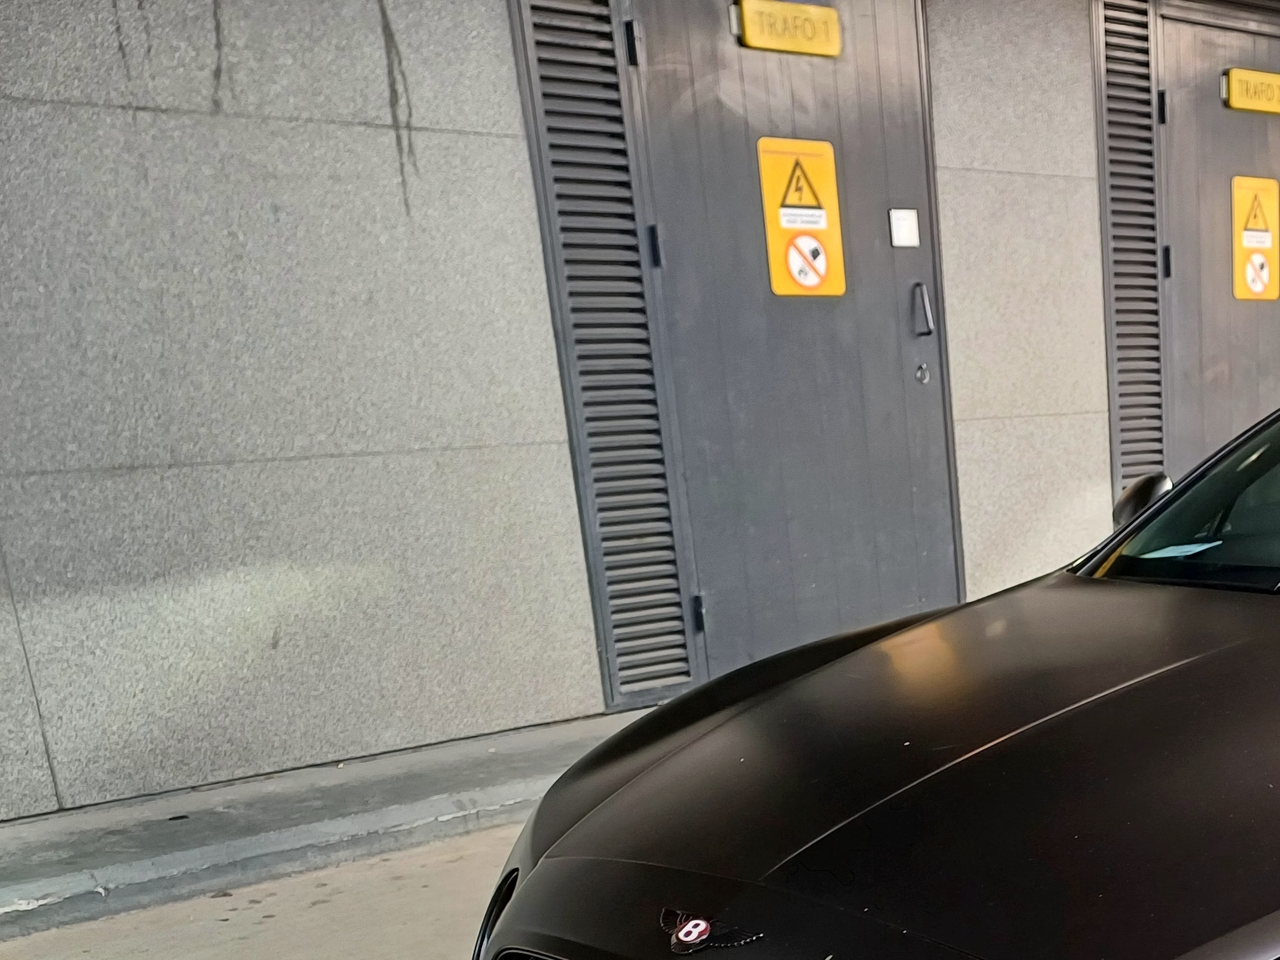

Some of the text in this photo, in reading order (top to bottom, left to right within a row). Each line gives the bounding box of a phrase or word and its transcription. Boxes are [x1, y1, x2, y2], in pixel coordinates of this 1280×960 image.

[755, 10, 830, 43] TRAFO 1
[1237, 79, 1274, 102] TRAFO
